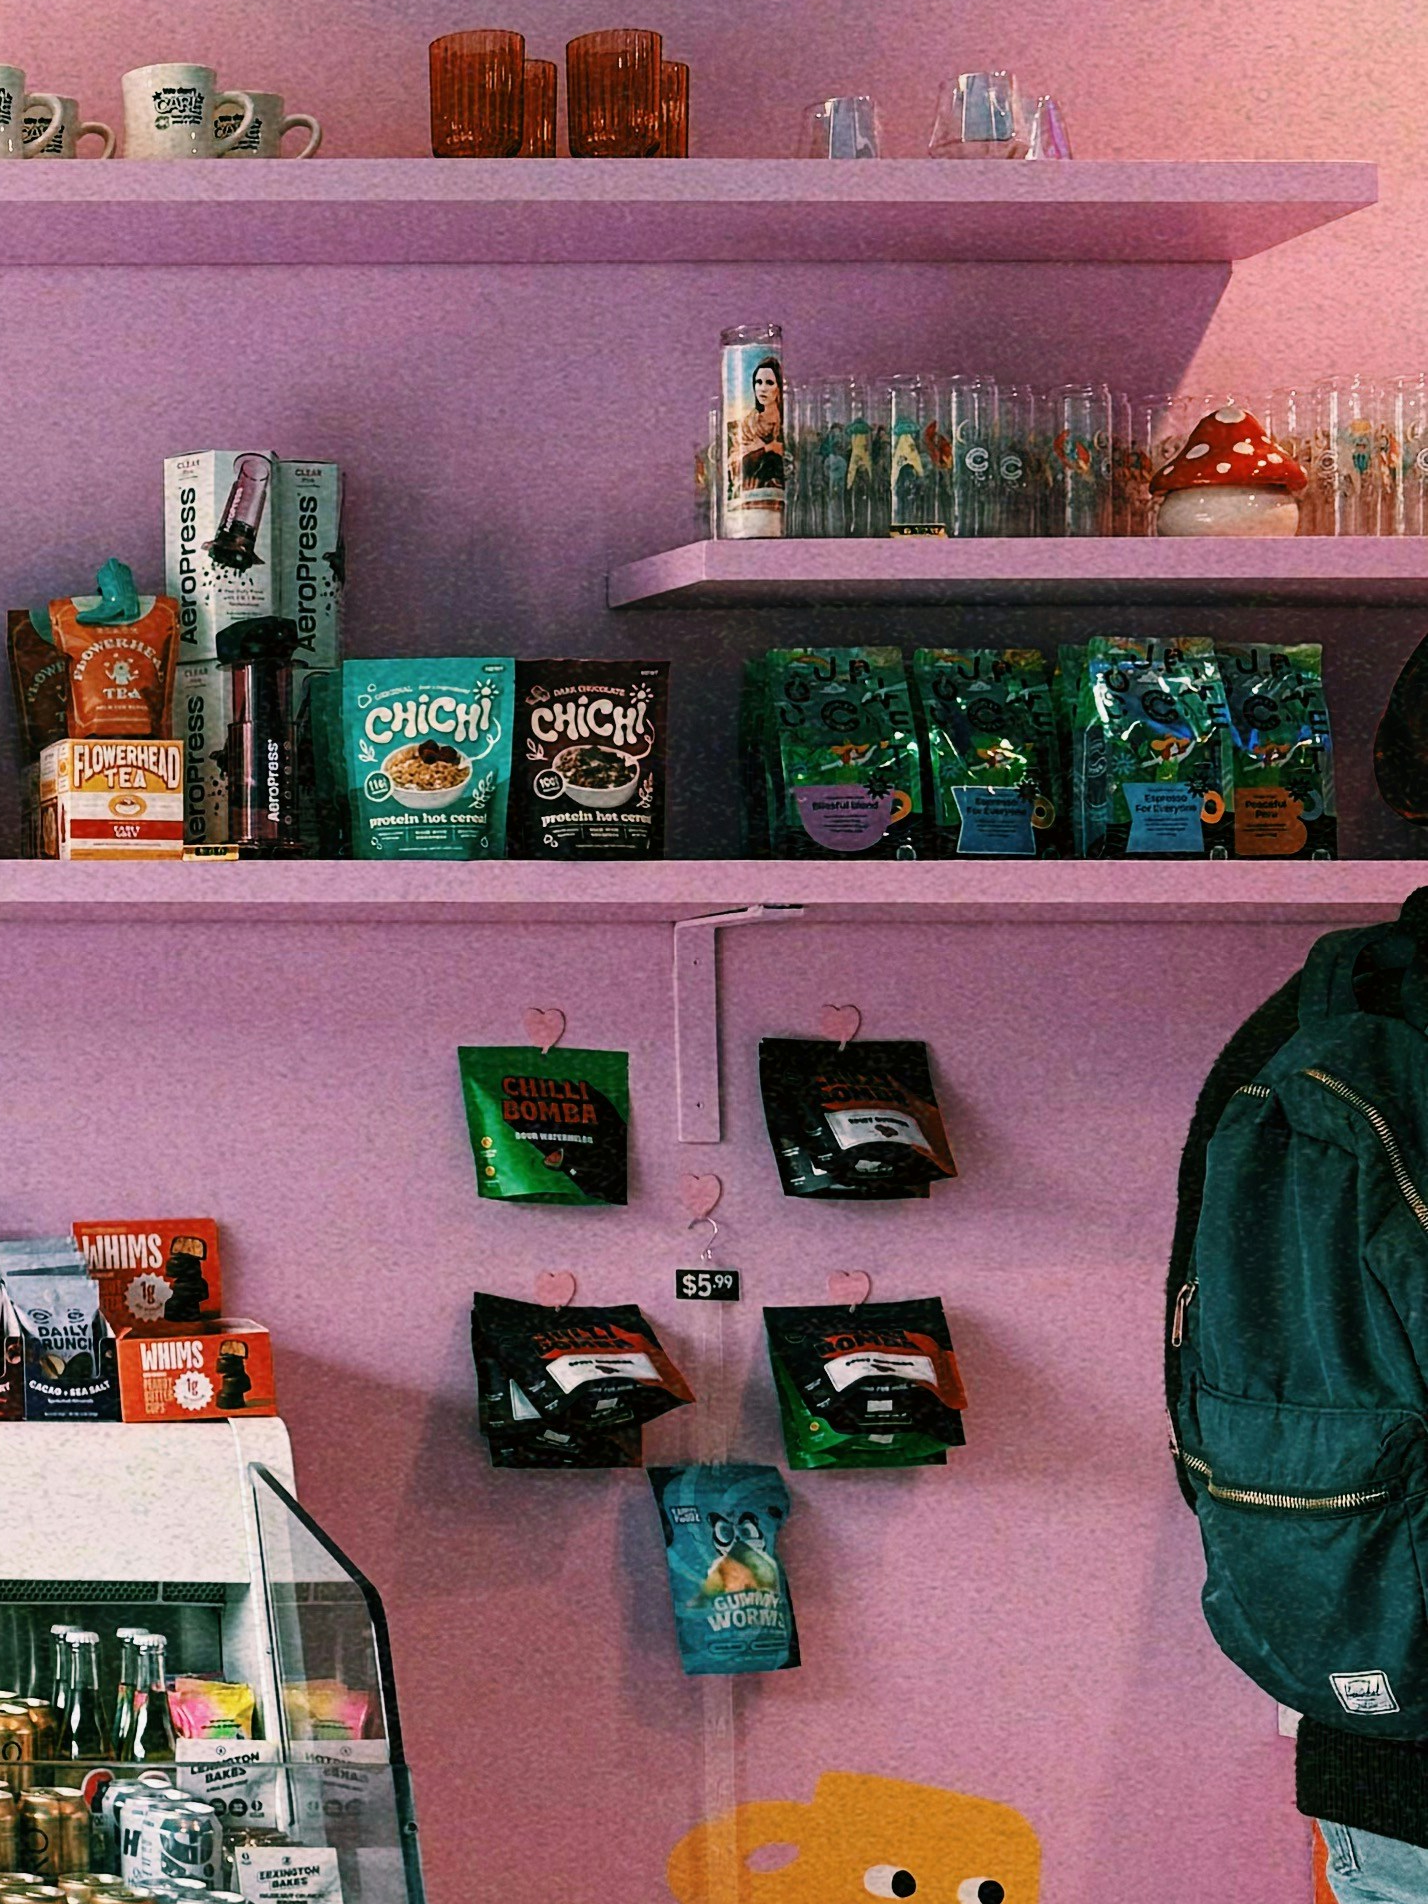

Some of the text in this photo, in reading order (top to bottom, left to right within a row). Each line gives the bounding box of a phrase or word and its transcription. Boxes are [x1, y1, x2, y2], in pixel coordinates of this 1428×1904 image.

[295, 469, 322, 477] CLEAR
[179, 486, 198, 646] AeroPress
[296, 495, 319, 654] AeroPress
[103, 688, 142, 700] TEA
[578, 685, 626, 696] CHOCOLATE
[73, 745, 180, 789] FLOWERHEAD
[104, 767, 148, 789] TEA
[1145, 794, 1187, 803] Espresso
[1245, 800, 1287, 809] Peaceful
[1135, 805, 1197, 814] For Everyone
[370, 813, 419, 828] protein
[422, 813, 448, 824] hot
[541, 810, 619, 827] protein hot
[502, 1077, 589, 1100] CHILLI
[503, 1100, 598, 1124] BOMBA
[82, 1233, 163, 1269] WHIMS
[139, 1281, 156, 1304] 1g
[681, 1273, 734, 1297] $5.99
[37, 1324, 88, 1337] DAILY
[139, 1340, 204, 1371] WHIMS
[29, 1380, 111, 1396] CACAO SEA SALT
[186, 1378, 199, 1396] 1g
[713, 1590, 781, 1611] GUMMY
[205, 1767, 248, 1783] BAKES
[259, 1866, 321, 1880] LEXINGTON
[272, 1877, 309, 1889] BAKES
